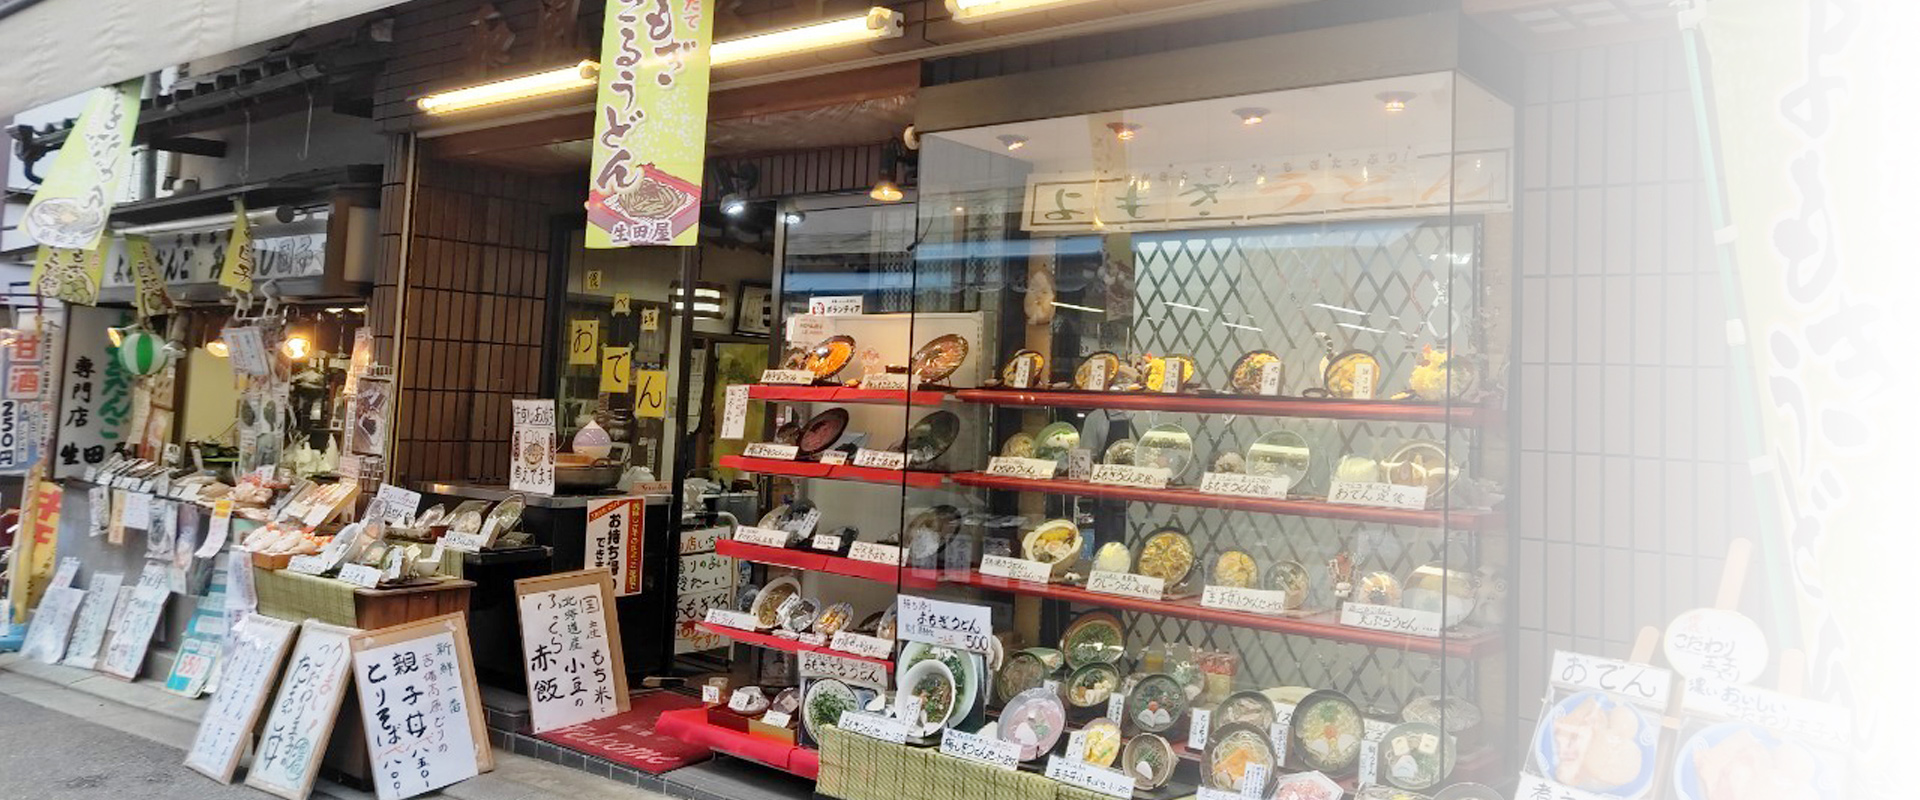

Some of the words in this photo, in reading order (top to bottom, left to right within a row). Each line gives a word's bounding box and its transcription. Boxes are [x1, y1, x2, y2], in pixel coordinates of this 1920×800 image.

[1044, 161, 1495, 221] よもぎうどん
[611, 221, 671, 244] 生田屋
[9, 335, 41, 394] 甘酒
[65, 356, 96, 427] 専門店
[60, 441, 130, 466] 生田
[916, 610, 982, 635] よもぎうどん
[391, 651, 428, 739] 親子丼
[530, 644, 565, 704] 赤飯
[1560, 655, 1657, 698] おでん
